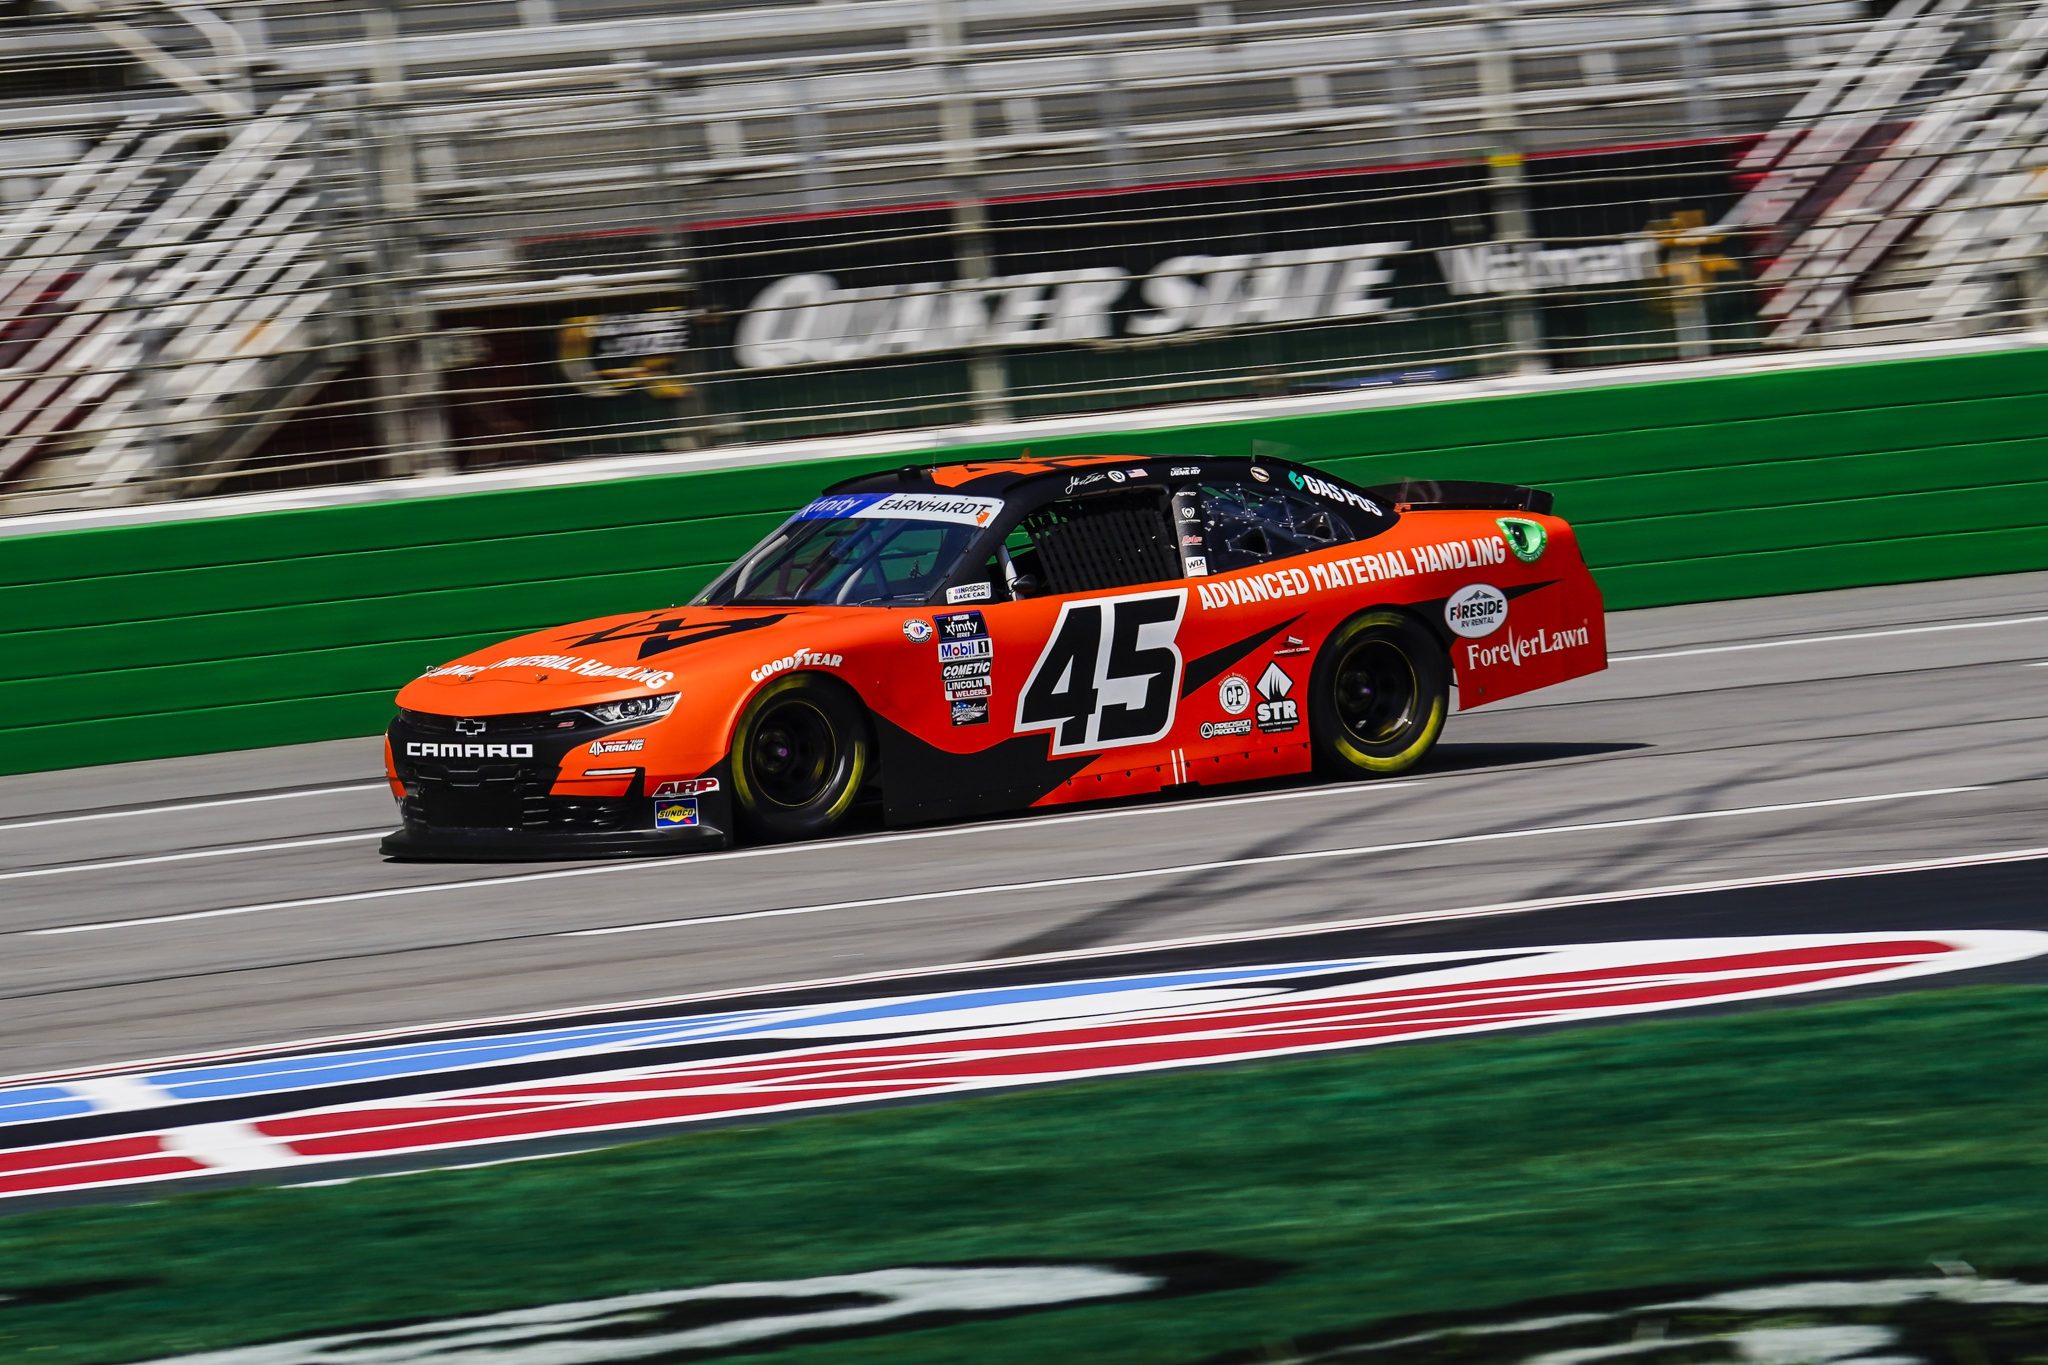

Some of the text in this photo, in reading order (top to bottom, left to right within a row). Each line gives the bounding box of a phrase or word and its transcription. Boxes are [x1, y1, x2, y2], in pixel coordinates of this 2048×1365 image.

[1303, 474, 1383, 516] GAS POS
[878, 499, 992, 516] EARNHARDT
[1197, 568, 1309, 610] ADVANCED
[1308, 550, 1415, 591] MATERIAL
[1410, 535, 1506, 576] HANDLING
[1450, 599, 1503, 621] FIRESIDE
[945, 621, 977, 635] xfinity
[1461, 616, 1495, 628] RV RENTAL
[941, 641, 975, 657] Mobil
[943, 661, 991, 677] COMETIC
[1013, 588, 1188, 755] 45
[947, 680, 983, 690] LINCOLN
[955, 688, 987, 697] WELDERS
[1257, 700, 1297, 721] STR
[1213, 727, 1251, 736] PRODUCTS
[406, 742, 533, 757] CAMARO
[605, 742, 643, 752] RACING
[656, 779, 718, 796] ARP
[659, 808, 694, 818] SUNOCO
